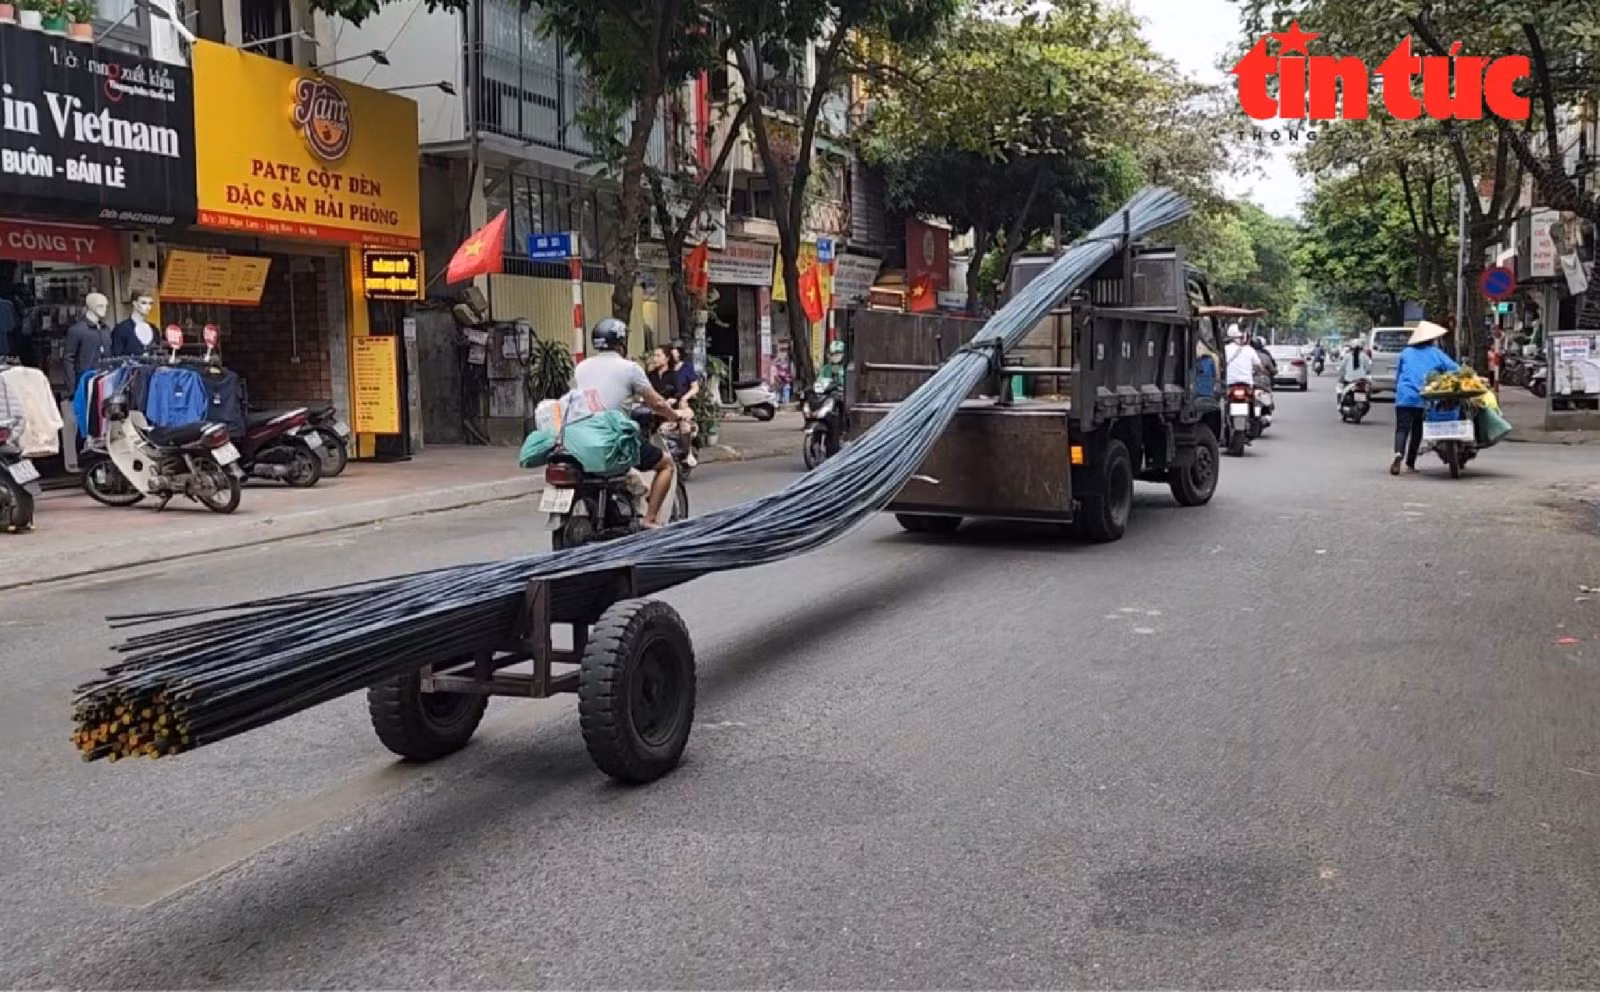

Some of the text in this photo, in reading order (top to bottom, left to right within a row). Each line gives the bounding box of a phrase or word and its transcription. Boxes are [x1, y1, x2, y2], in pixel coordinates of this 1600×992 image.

[2, 84, 180, 158] in Vietnam
[2, 146, 53, 178] BUÔN
[66, 154, 102, 185] BÁN
[105, 156, 126, 188] LẺ
[252, 159, 381, 197] PATE CỘT ĐÈN
[226, 182, 399, 226] ĐẶC SẢN HẢI PHÒNG
[8, 229, 67, 251] CÔNG
